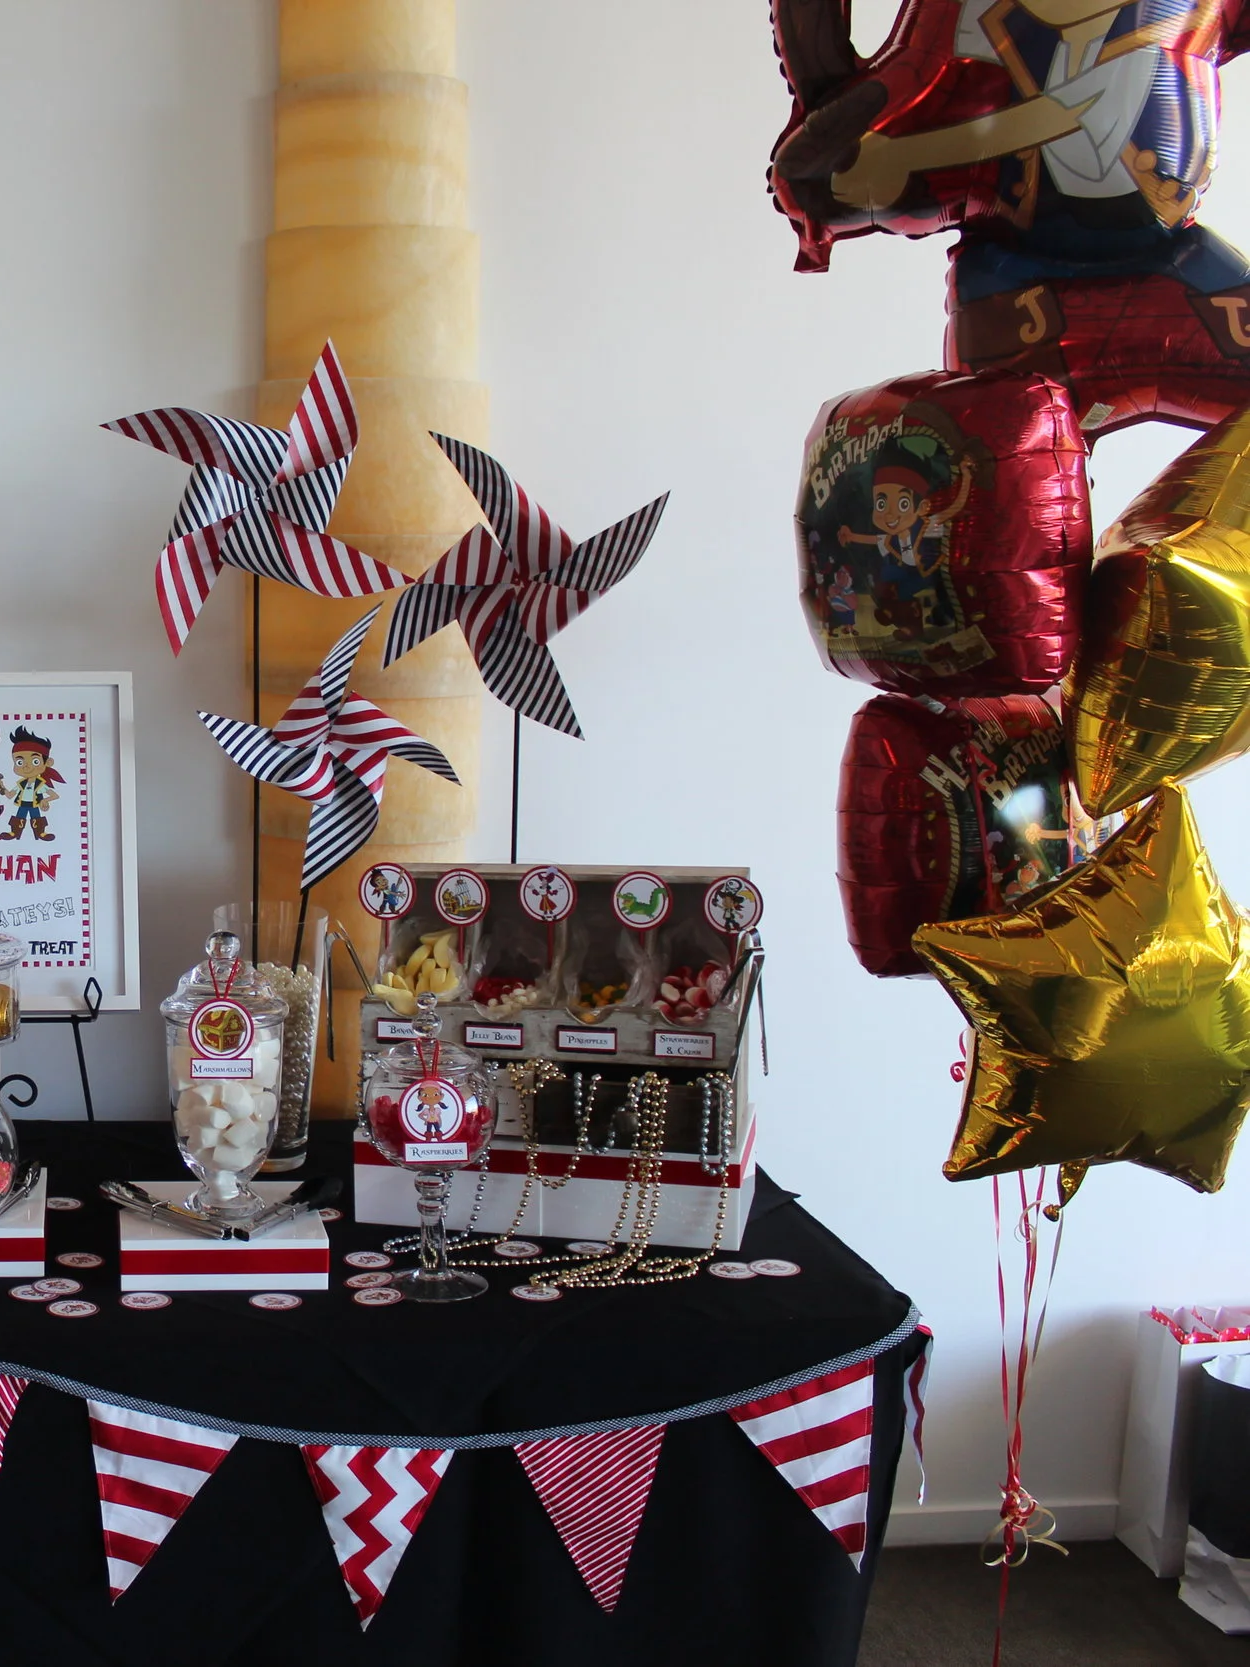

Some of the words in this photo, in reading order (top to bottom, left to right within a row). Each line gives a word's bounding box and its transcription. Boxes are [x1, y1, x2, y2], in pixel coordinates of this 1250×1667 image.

[1014, 285, 1047, 344] J
[810, 414, 904, 510] BIRTHDAY
[978, 724, 1063, 811] BIRTHDA
[28, 940, 78, 955] TREAT
